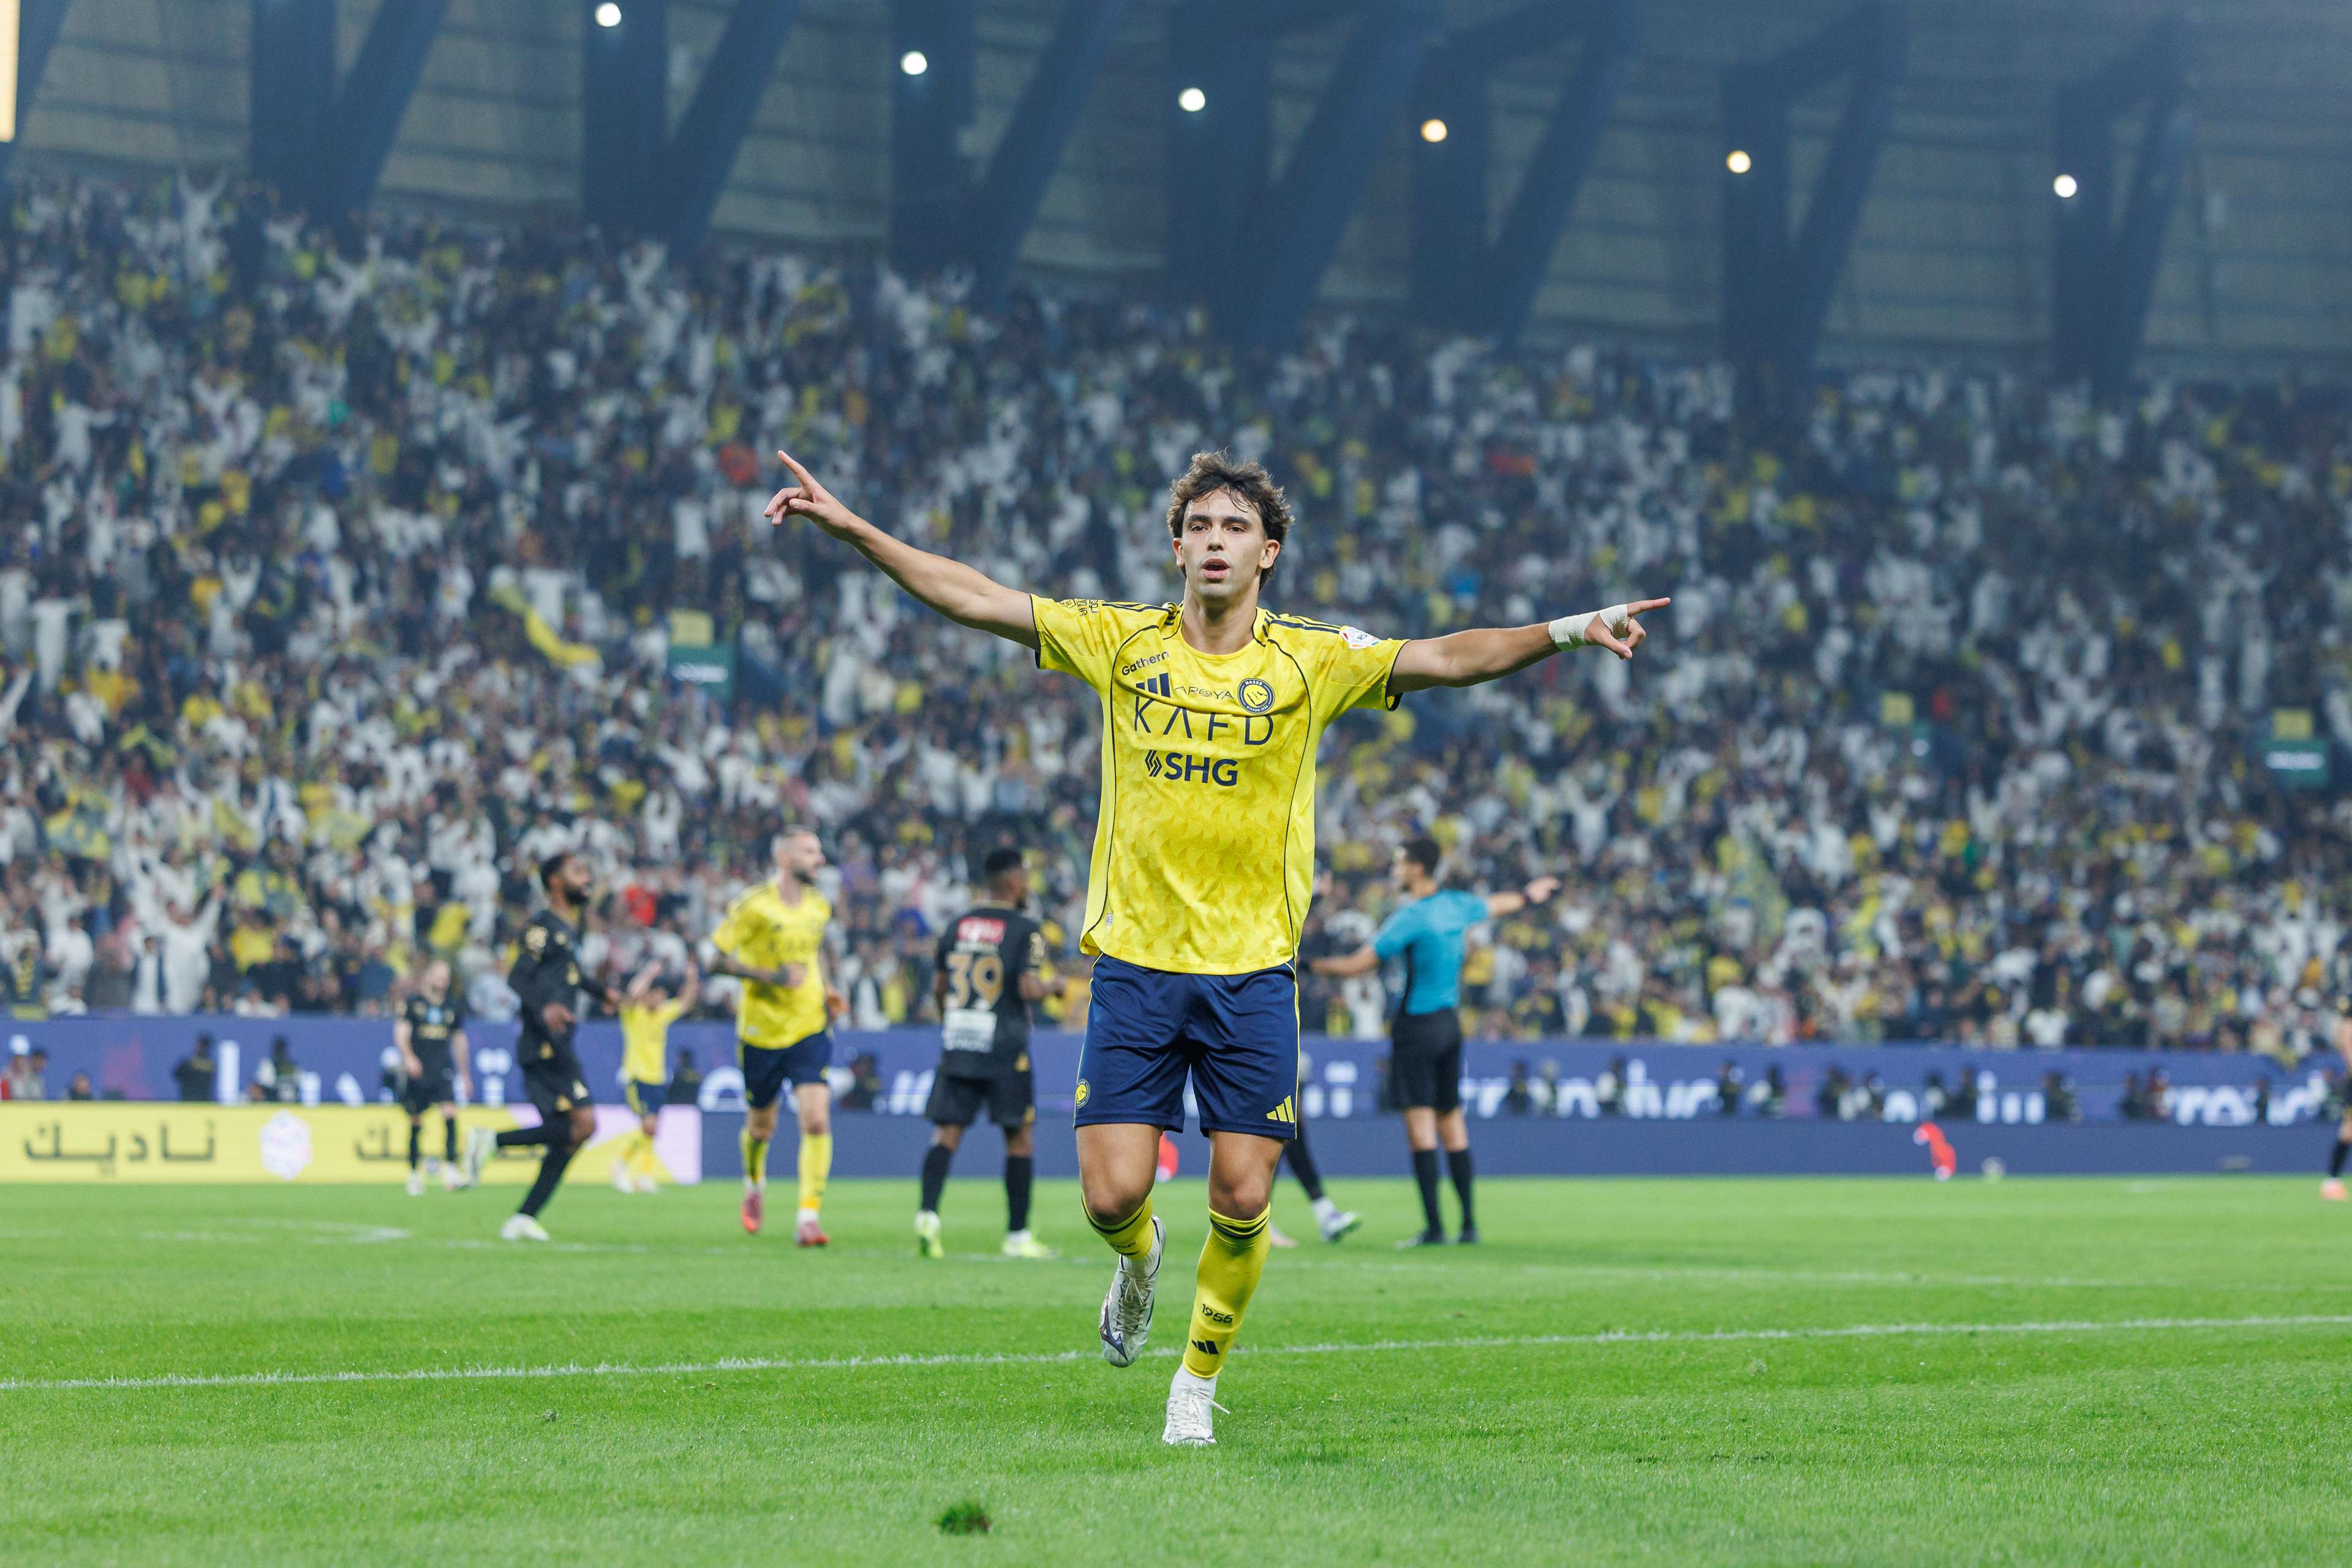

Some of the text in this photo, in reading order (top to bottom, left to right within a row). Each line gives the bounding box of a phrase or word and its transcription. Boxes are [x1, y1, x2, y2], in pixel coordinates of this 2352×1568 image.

[1121, 651, 1170, 676] Gathern
[1164, 752, 1238, 786] SHG
[943, 951, 1005, 1011] 39
[23, 1118, 215, 1176] ناديك
[1202, 1303, 1234, 1324] 1956
